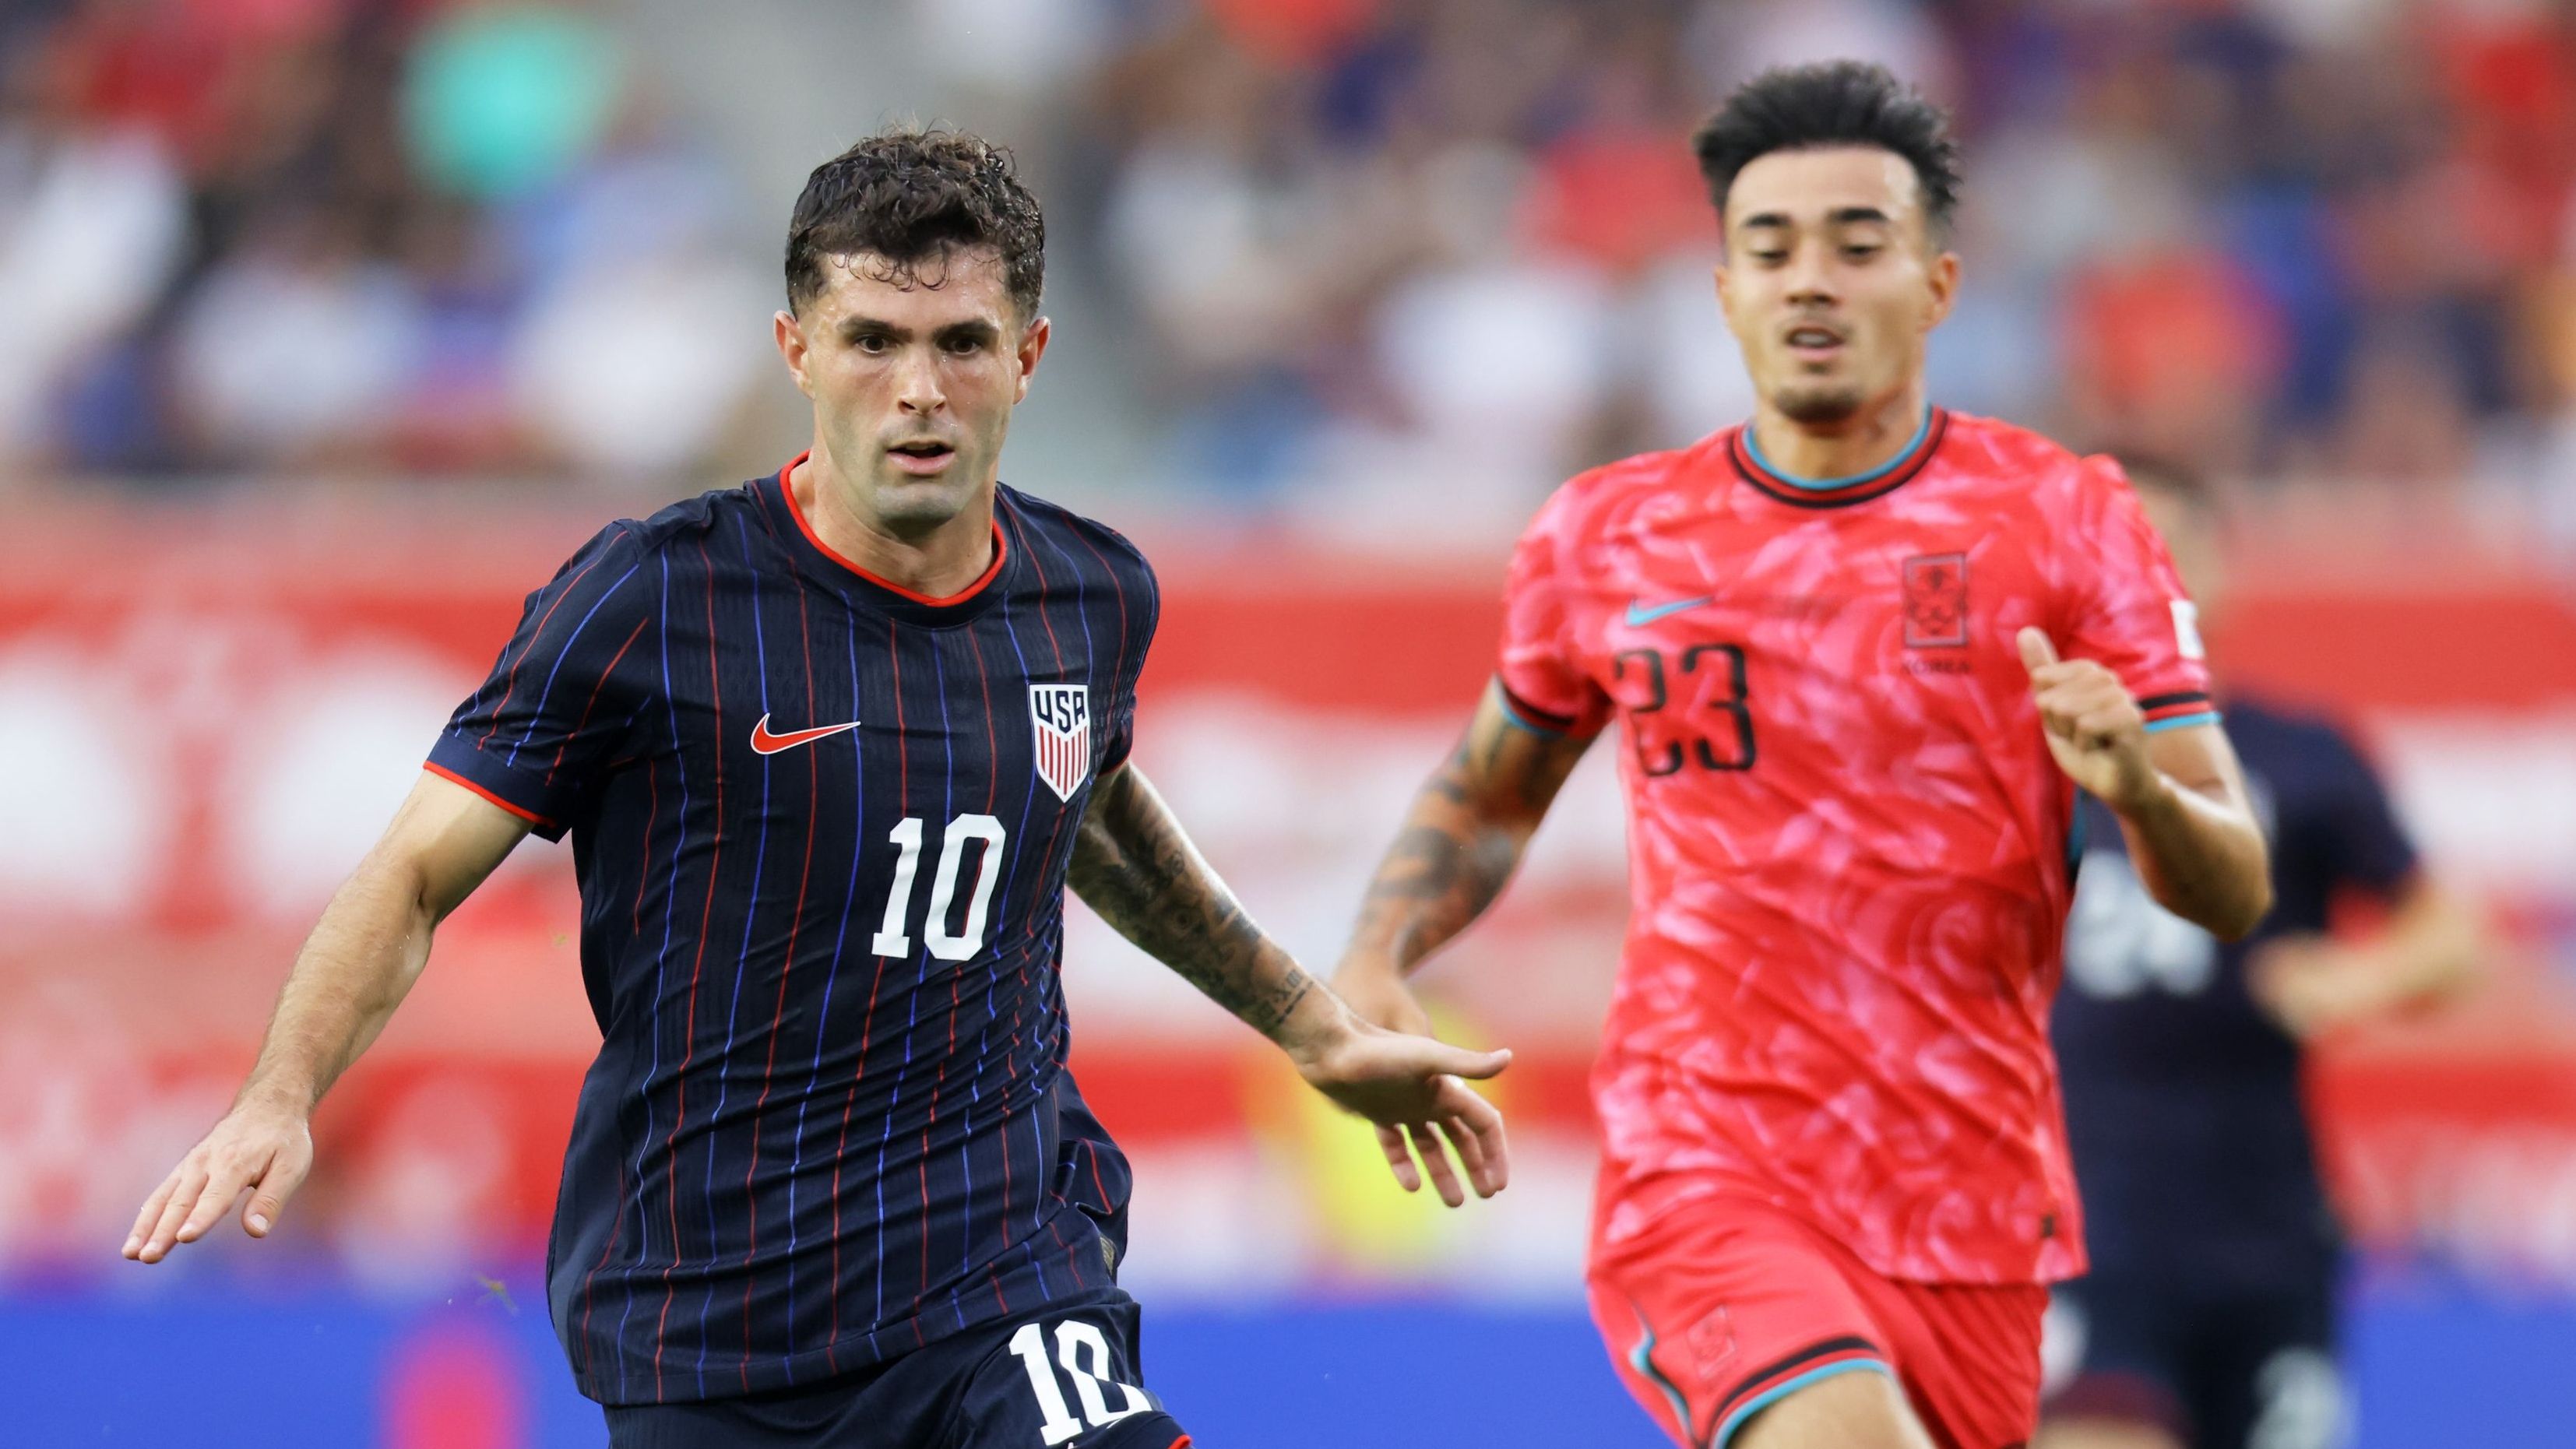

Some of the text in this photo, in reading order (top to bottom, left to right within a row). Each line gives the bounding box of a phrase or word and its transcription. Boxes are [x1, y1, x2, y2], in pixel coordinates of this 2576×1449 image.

[1034, 691, 1086, 733] USA
[1615, 643, 1758, 776] 23
[871, 813, 1007, 961] 10
[1008, 1320, 1153, 1446] 10
